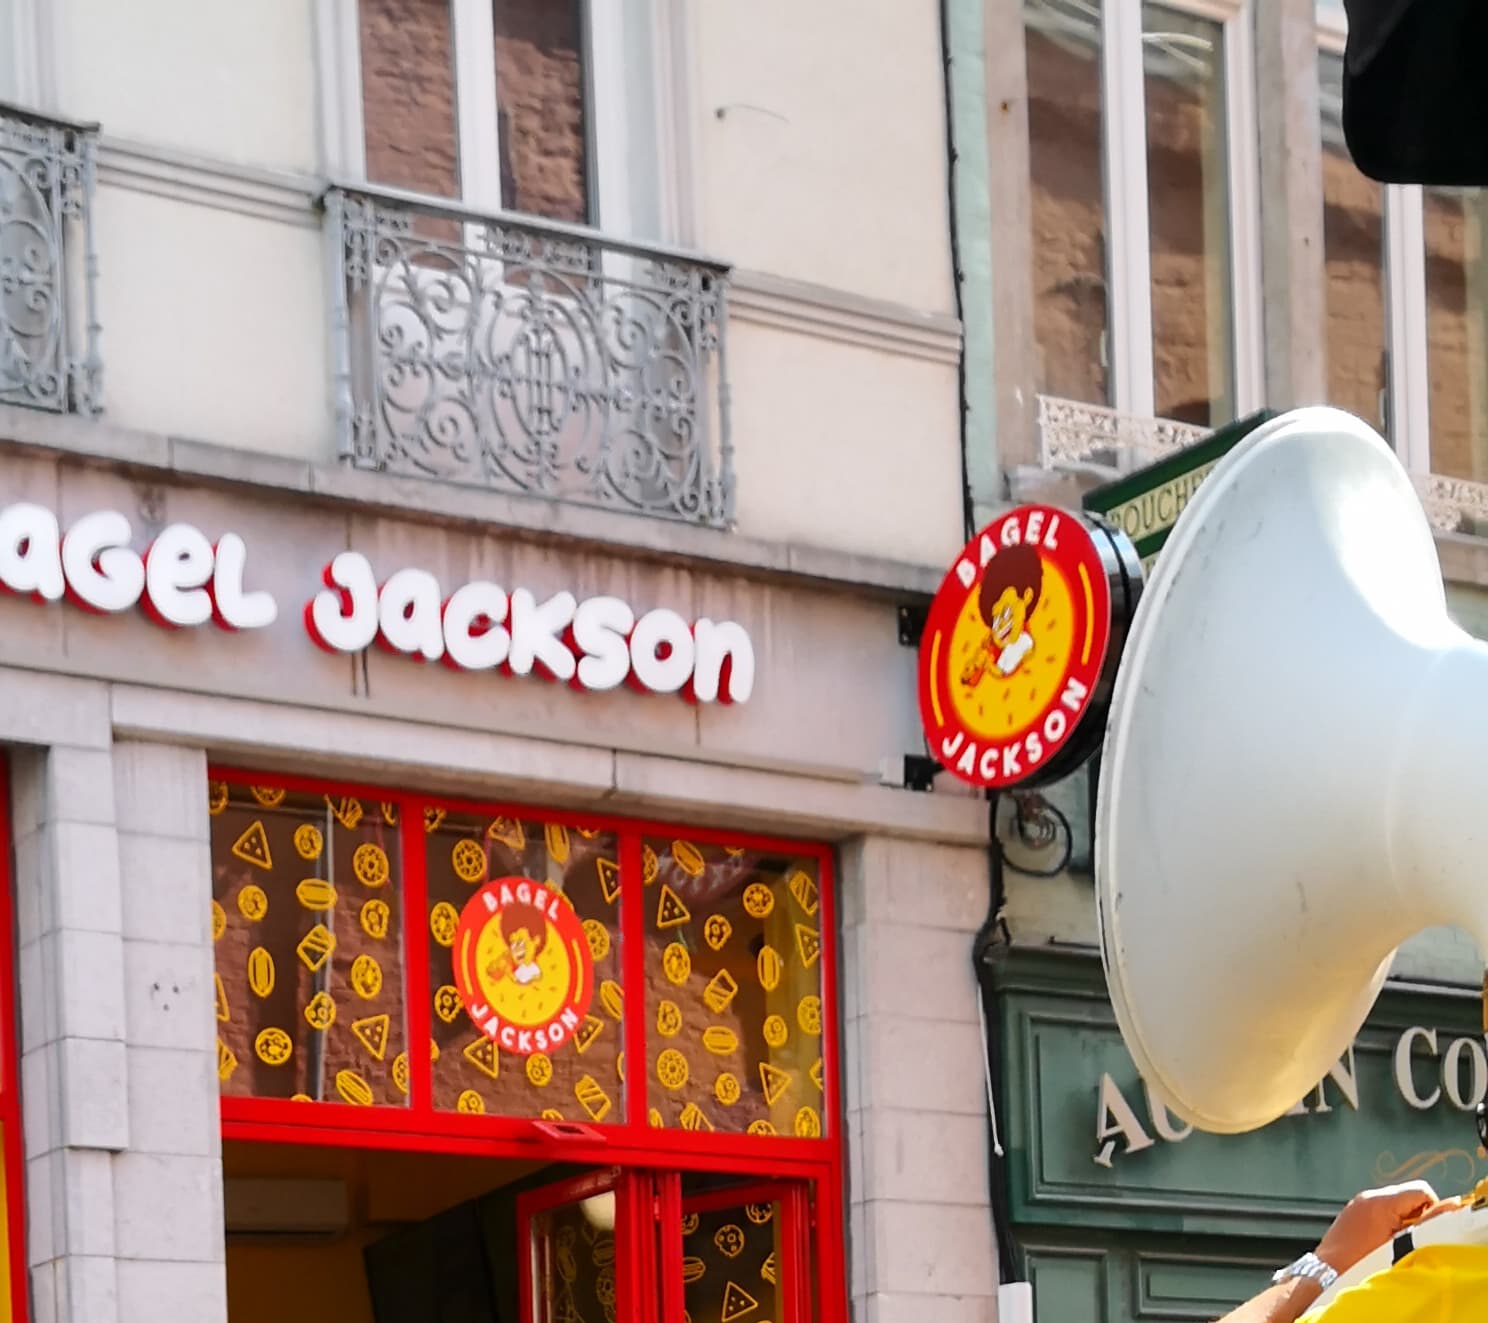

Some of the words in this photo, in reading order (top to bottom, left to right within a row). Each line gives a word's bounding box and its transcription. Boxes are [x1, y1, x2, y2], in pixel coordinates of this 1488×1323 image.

[955, 510, 1061, 589] BAGEL
[942, 676, 1088, 780] JACKSON
[481, 882, 560, 922] BAGEL
[471, 1003, 579, 1052] JACKSON
